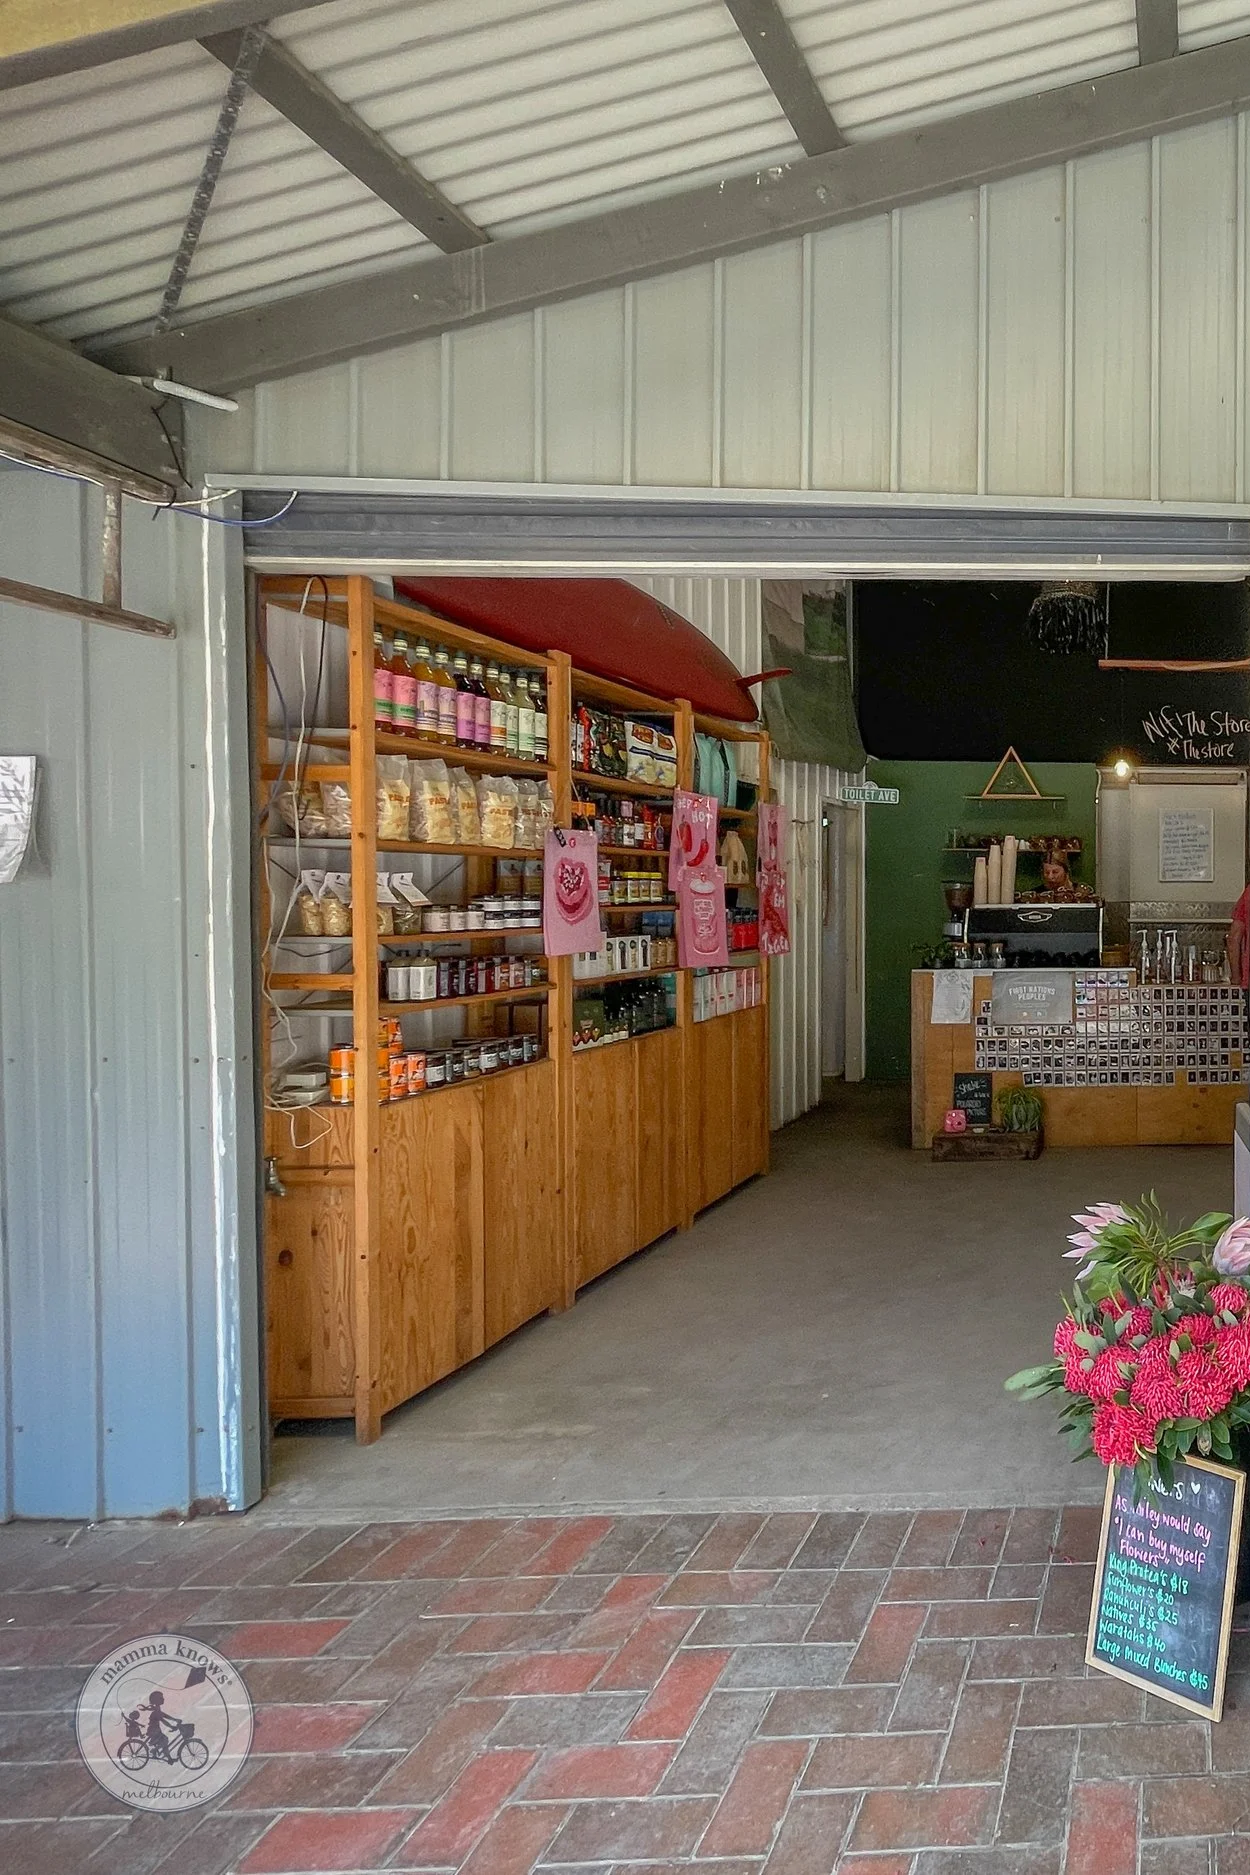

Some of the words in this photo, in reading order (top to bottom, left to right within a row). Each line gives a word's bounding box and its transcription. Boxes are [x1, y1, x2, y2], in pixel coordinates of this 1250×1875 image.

[1182, 711, 1209, 736] The
[844, 788, 876, 800] TOILET
[878, 790, 897, 801] AVE
[1162, 1512, 1191, 1535] would
[1194, 1522, 1212, 1548] say
[1126, 1524, 1145, 1543] can
[1149, 1530, 1168, 1559] buy
[1169, 1544, 1206, 1573] myself
[1107, 1571, 1154, 1599] Sunflower's
[1156, 1588, 1174, 1605] $20
[1109, 1552, 1128, 1577] King
[1129, 1559, 1168, 1587] Protea's
[1170, 1573, 1189, 1595] $18
[1101, 1604, 1134, 1625] Natives
[1139, 1614, 1159, 1632] $35
[1157, 1606, 1178, 1626] $25
[1100, 1618, 1144, 1645] Waratahs
[1146, 1633, 1166, 1653] $40
[1096, 1633, 1121, 1662] Large
[1154, 1657, 1187, 1683] Bunches
[1189, 1668, 1209, 1690] $45
